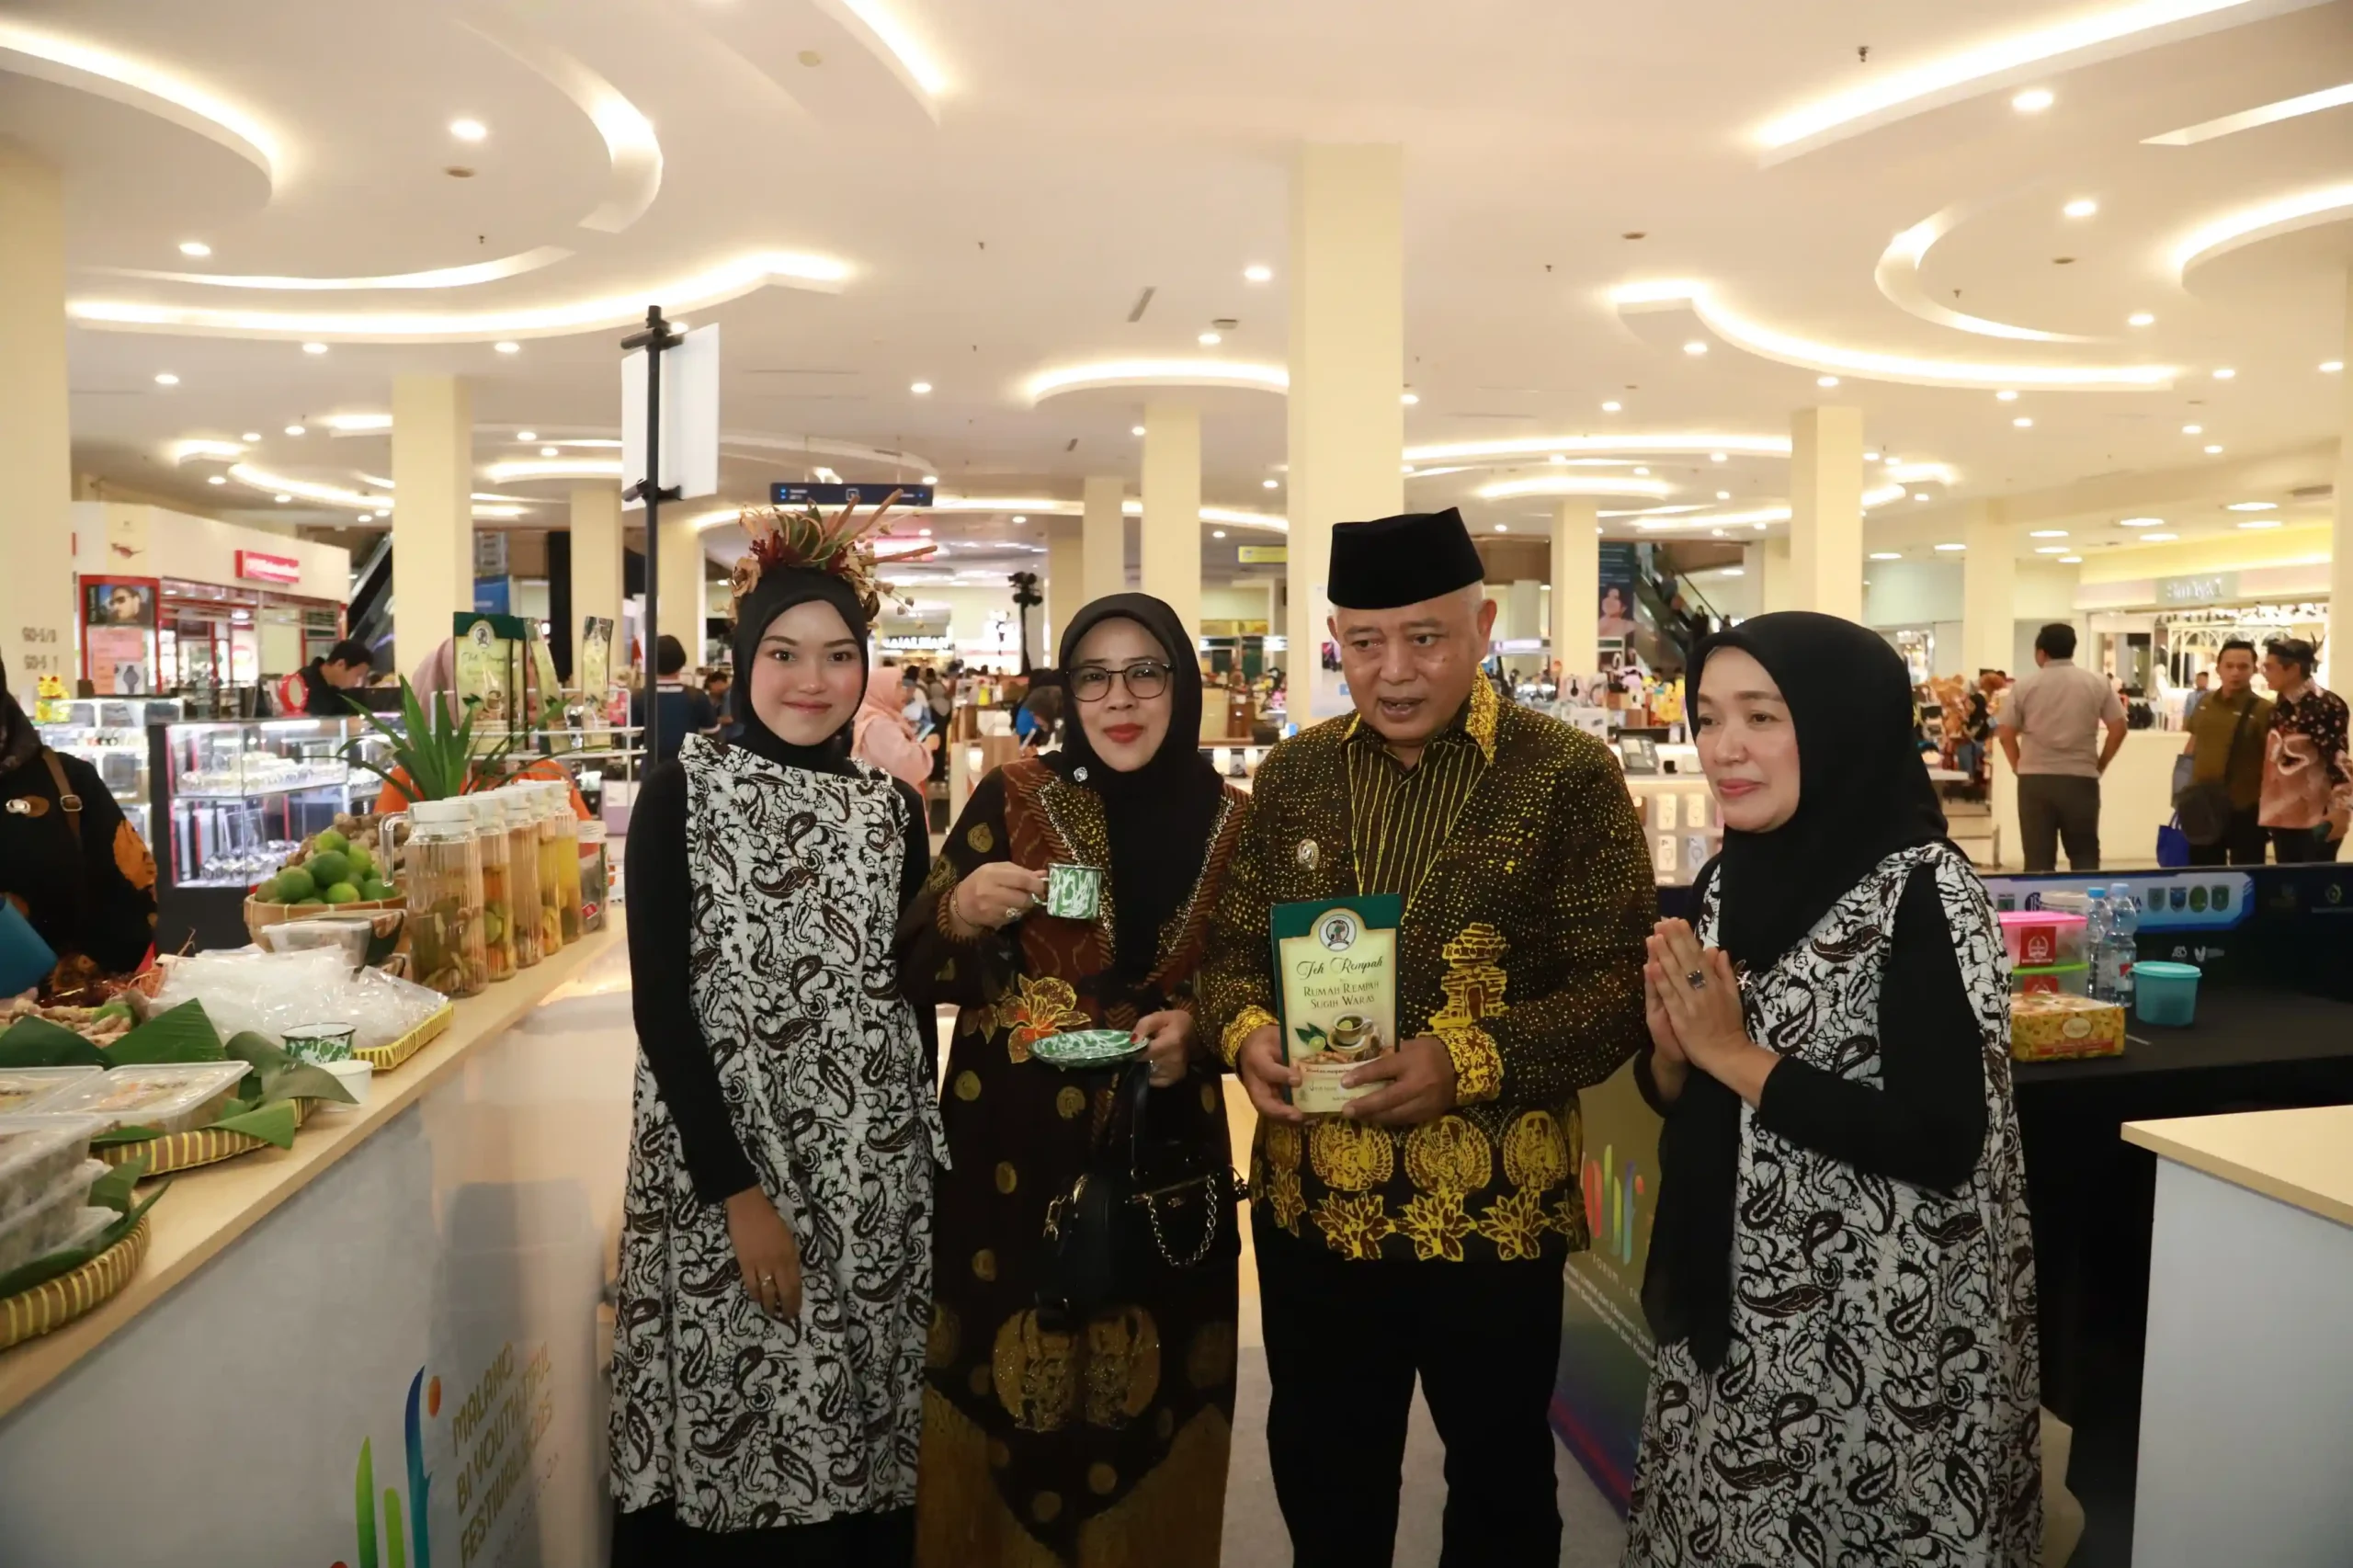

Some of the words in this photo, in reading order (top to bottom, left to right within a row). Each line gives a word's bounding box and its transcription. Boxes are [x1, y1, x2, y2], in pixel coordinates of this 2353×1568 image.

[1296, 960, 1324, 981] Teh
[1330, 956, 1383, 974] Rempah
[1303, 985, 1340, 997] RUMAH
[1343, 982, 1380, 994] REMPAH
[1311, 998, 1338, 1010] SUGIH
[1342, 994, 1375, 1006] WARAS
[453, 1340, 514, 1458] MALANG
